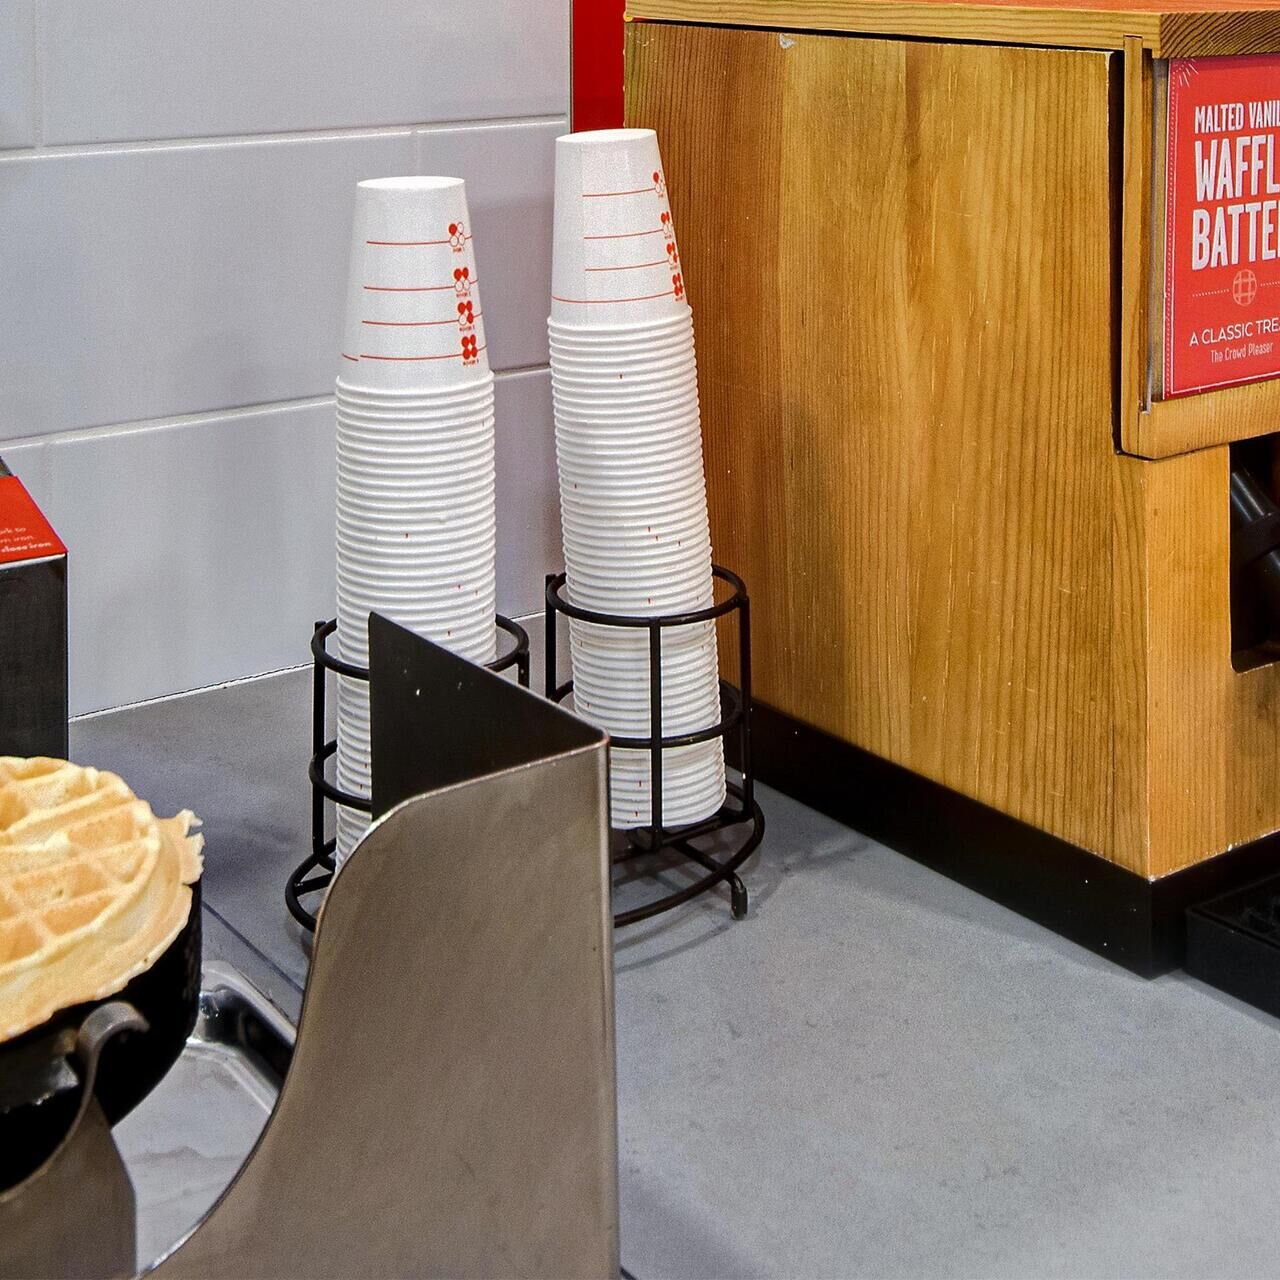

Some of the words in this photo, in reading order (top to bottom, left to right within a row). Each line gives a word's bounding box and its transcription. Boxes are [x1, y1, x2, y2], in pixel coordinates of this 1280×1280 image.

[1194, 102, 1245, 134] MALTED
[1189, 331, 1199, 347] A
[1201, 322, 1253, 345] CLASSIC
[1211, 349, 1223, 364] The
[1224, 343, 1247, 361] Crowd
[1248, 342, 1274, 357] Pleaser
